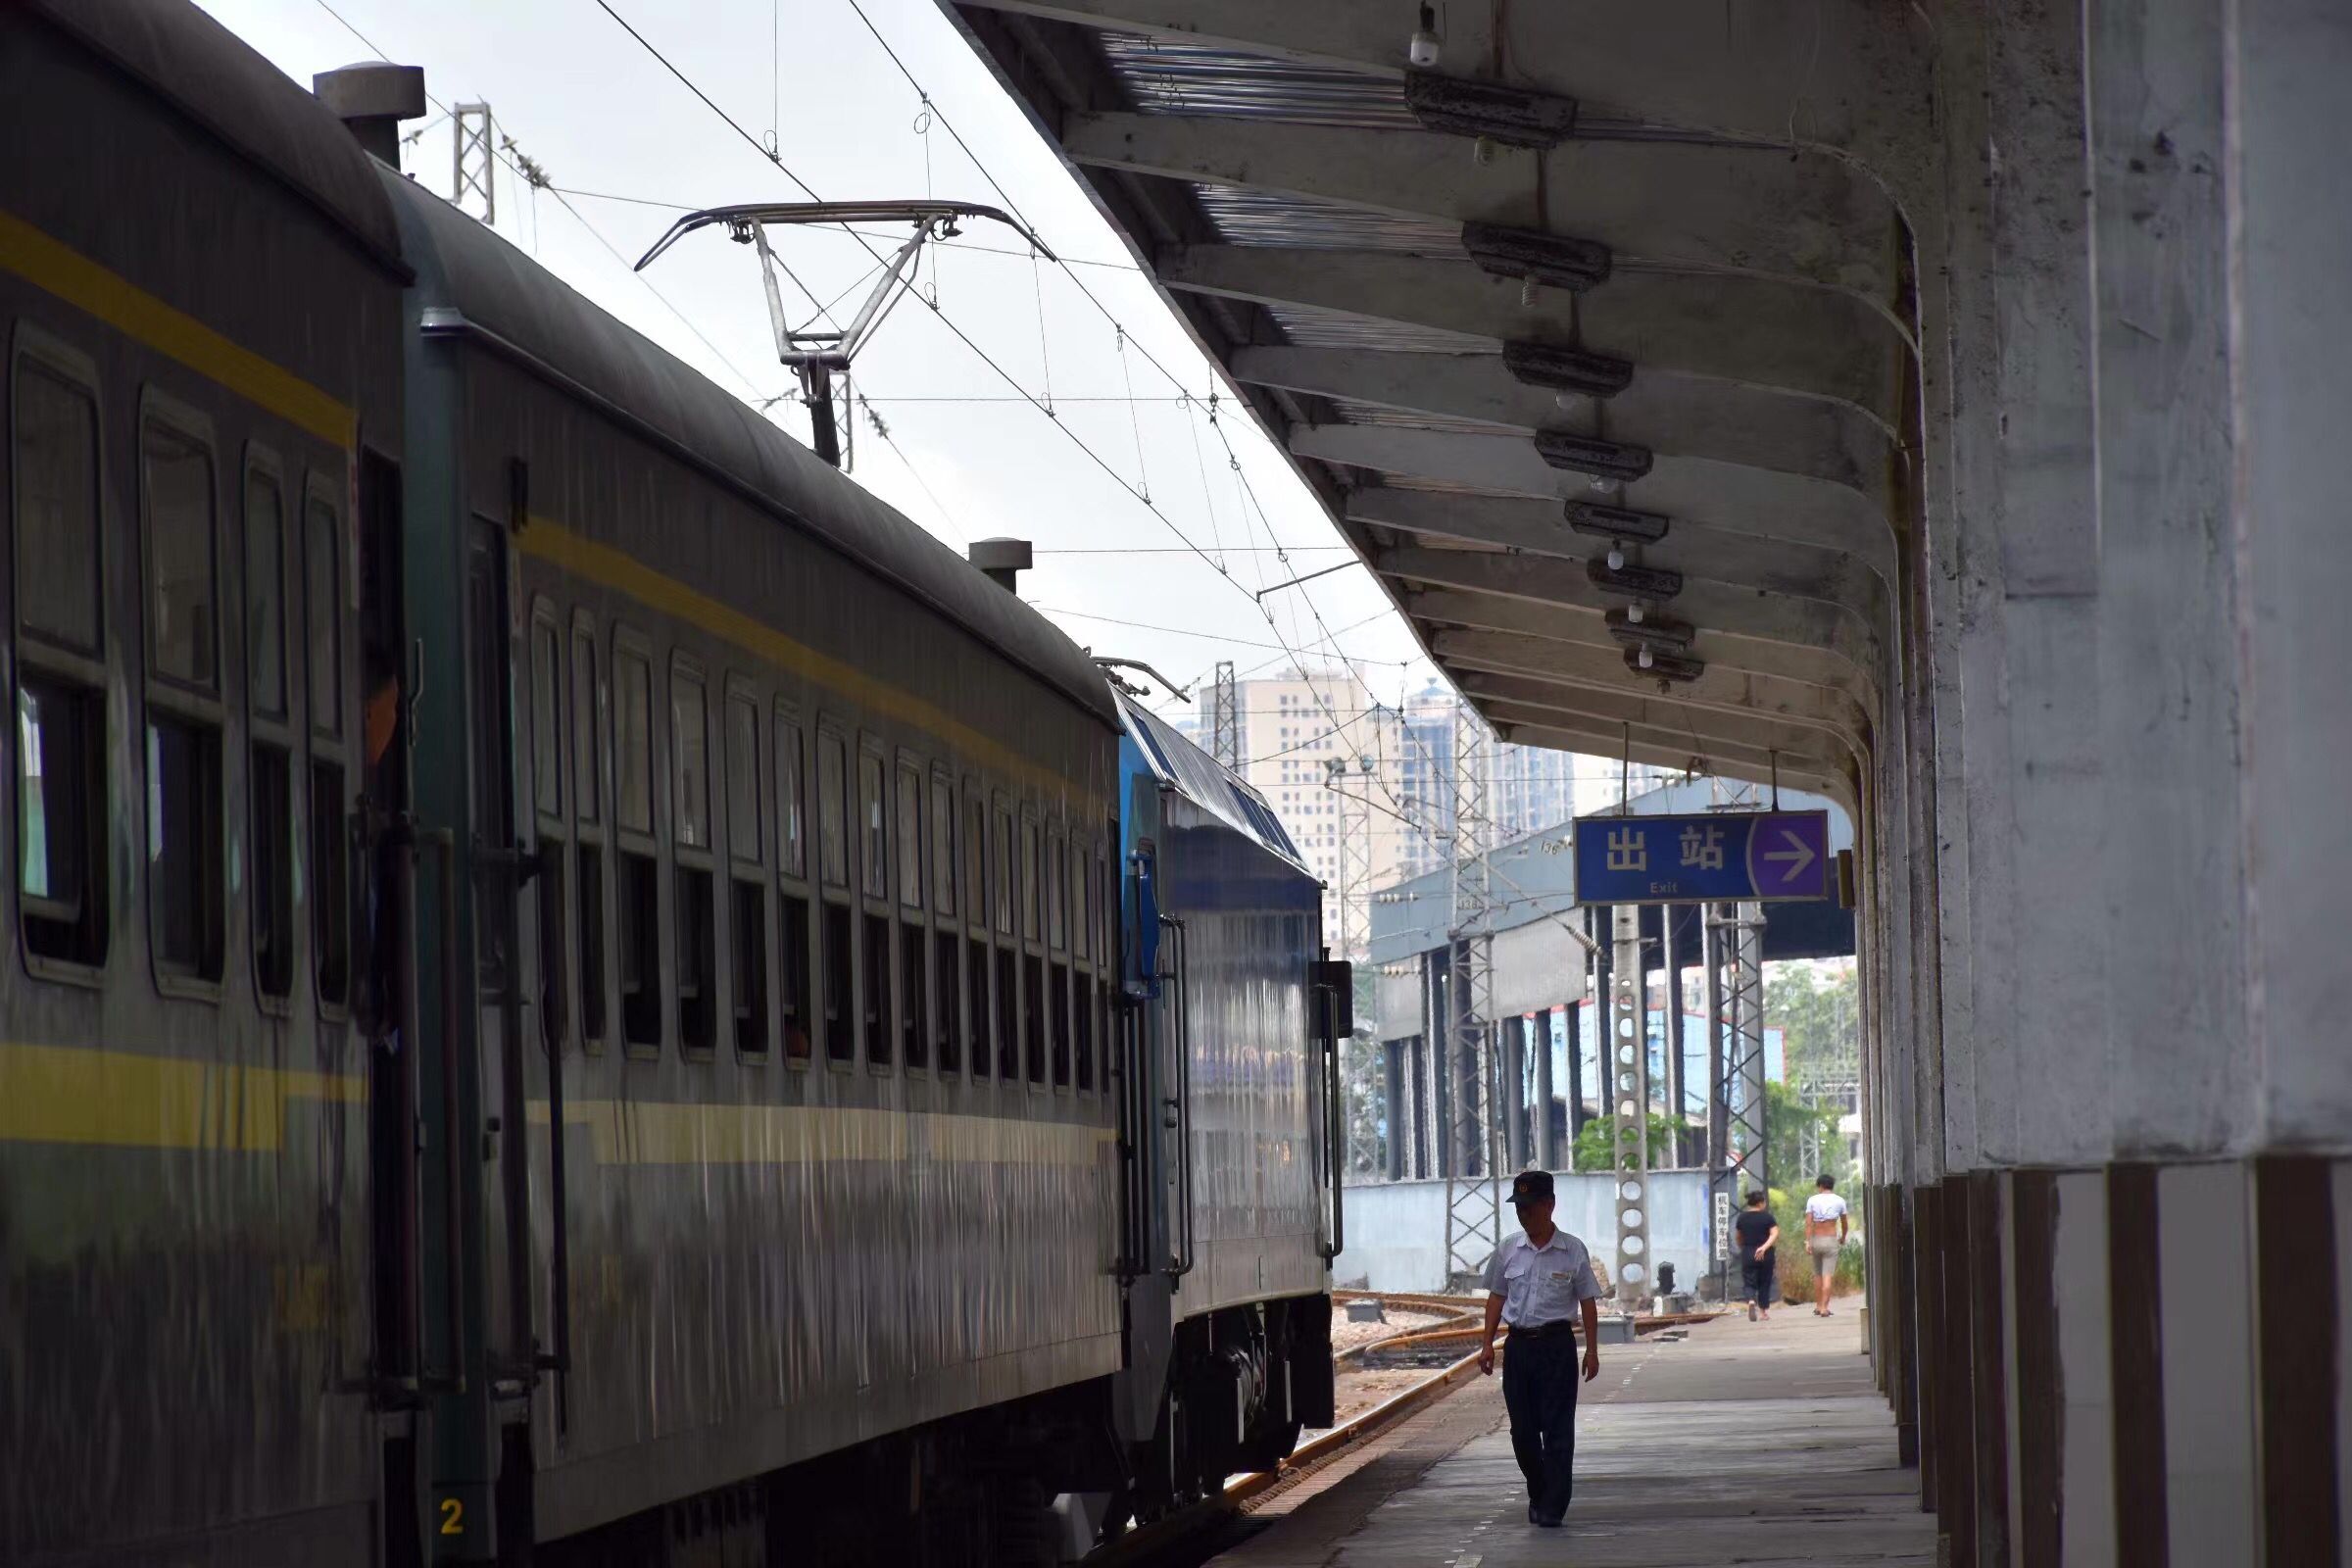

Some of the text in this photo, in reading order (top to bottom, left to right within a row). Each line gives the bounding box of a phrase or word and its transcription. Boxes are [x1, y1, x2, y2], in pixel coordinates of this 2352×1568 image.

[1607, 825, 1725, 871] 出站
[1649, 881, 1678, 894] Exit
[441, 1498, 464, 1535] 2
